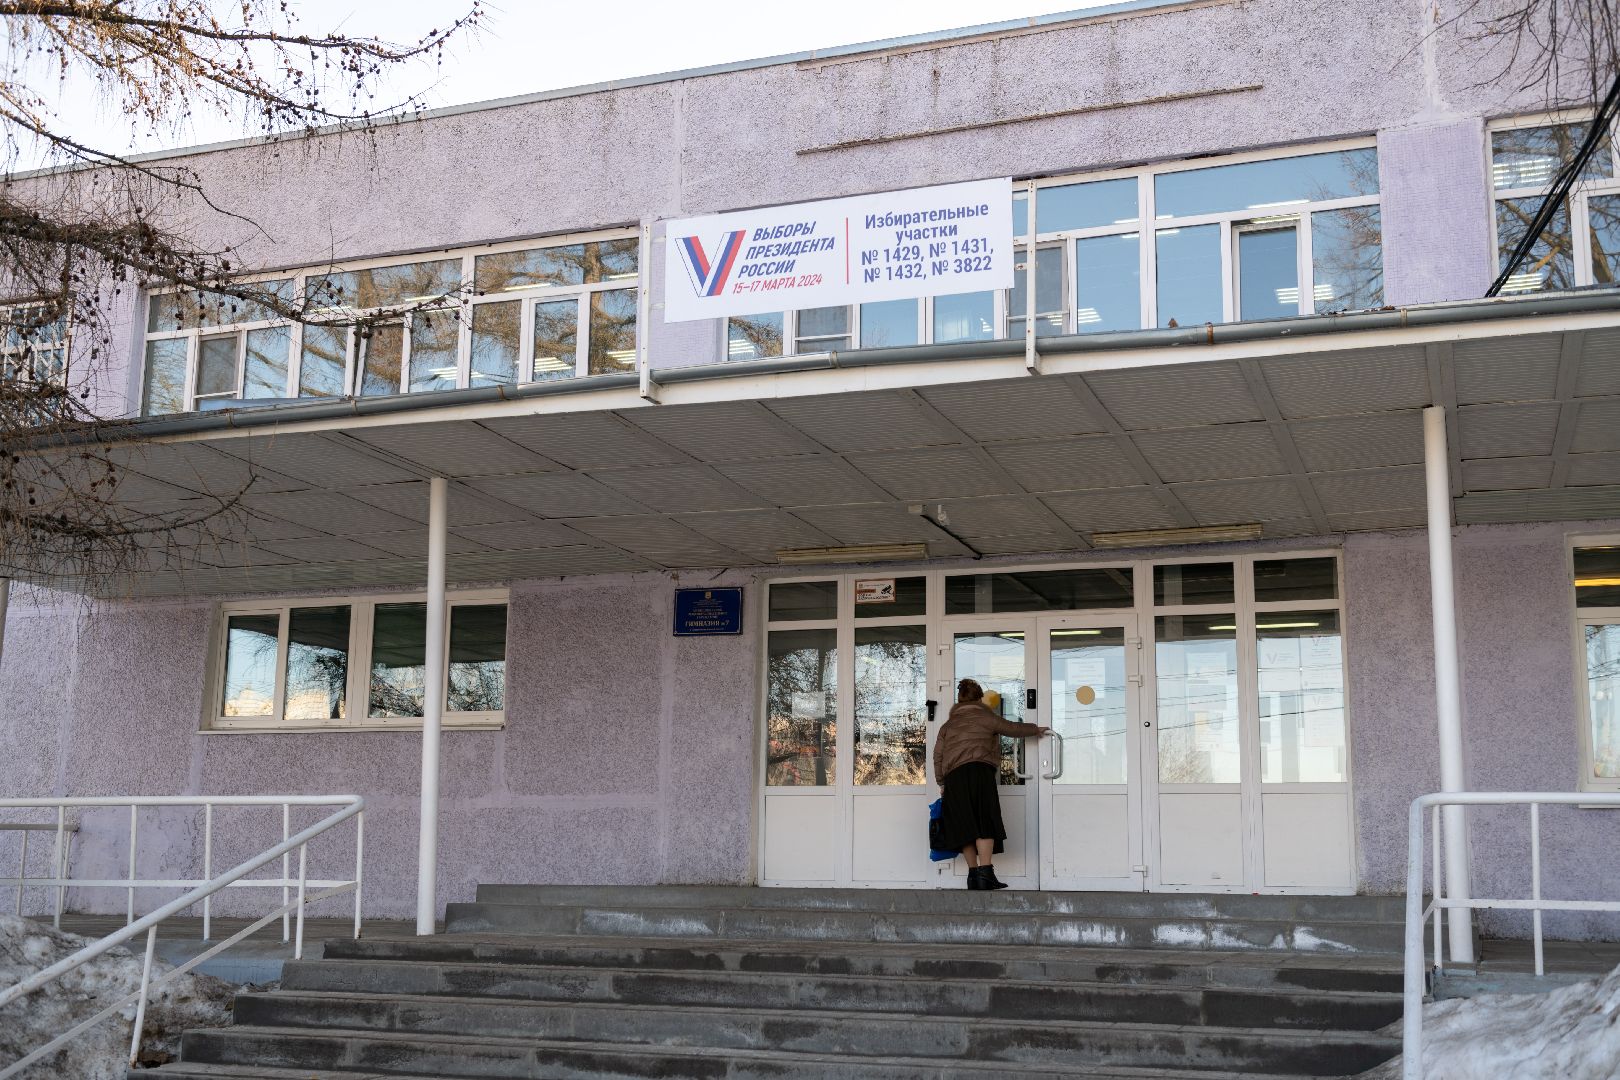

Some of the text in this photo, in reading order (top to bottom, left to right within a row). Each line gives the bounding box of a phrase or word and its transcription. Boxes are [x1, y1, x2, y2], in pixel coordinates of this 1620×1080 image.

[865, 204, 989, 229] Избирательные
[753, 221, 816, 241] ВЫБОРЫ
[895, 225, 958, 246] участки
[745, 237, 835, 259] ПРЕЗИДЕНТА
[861, 238, 994, 265] № 1429, № 1431,
[738, 259, 796, 278] РОССИИ
[864, 256, 992, 283] № 1432, № 3822
[761, 276, 796, 291] МАРТА
[797, 274, 823, 287] 2024
